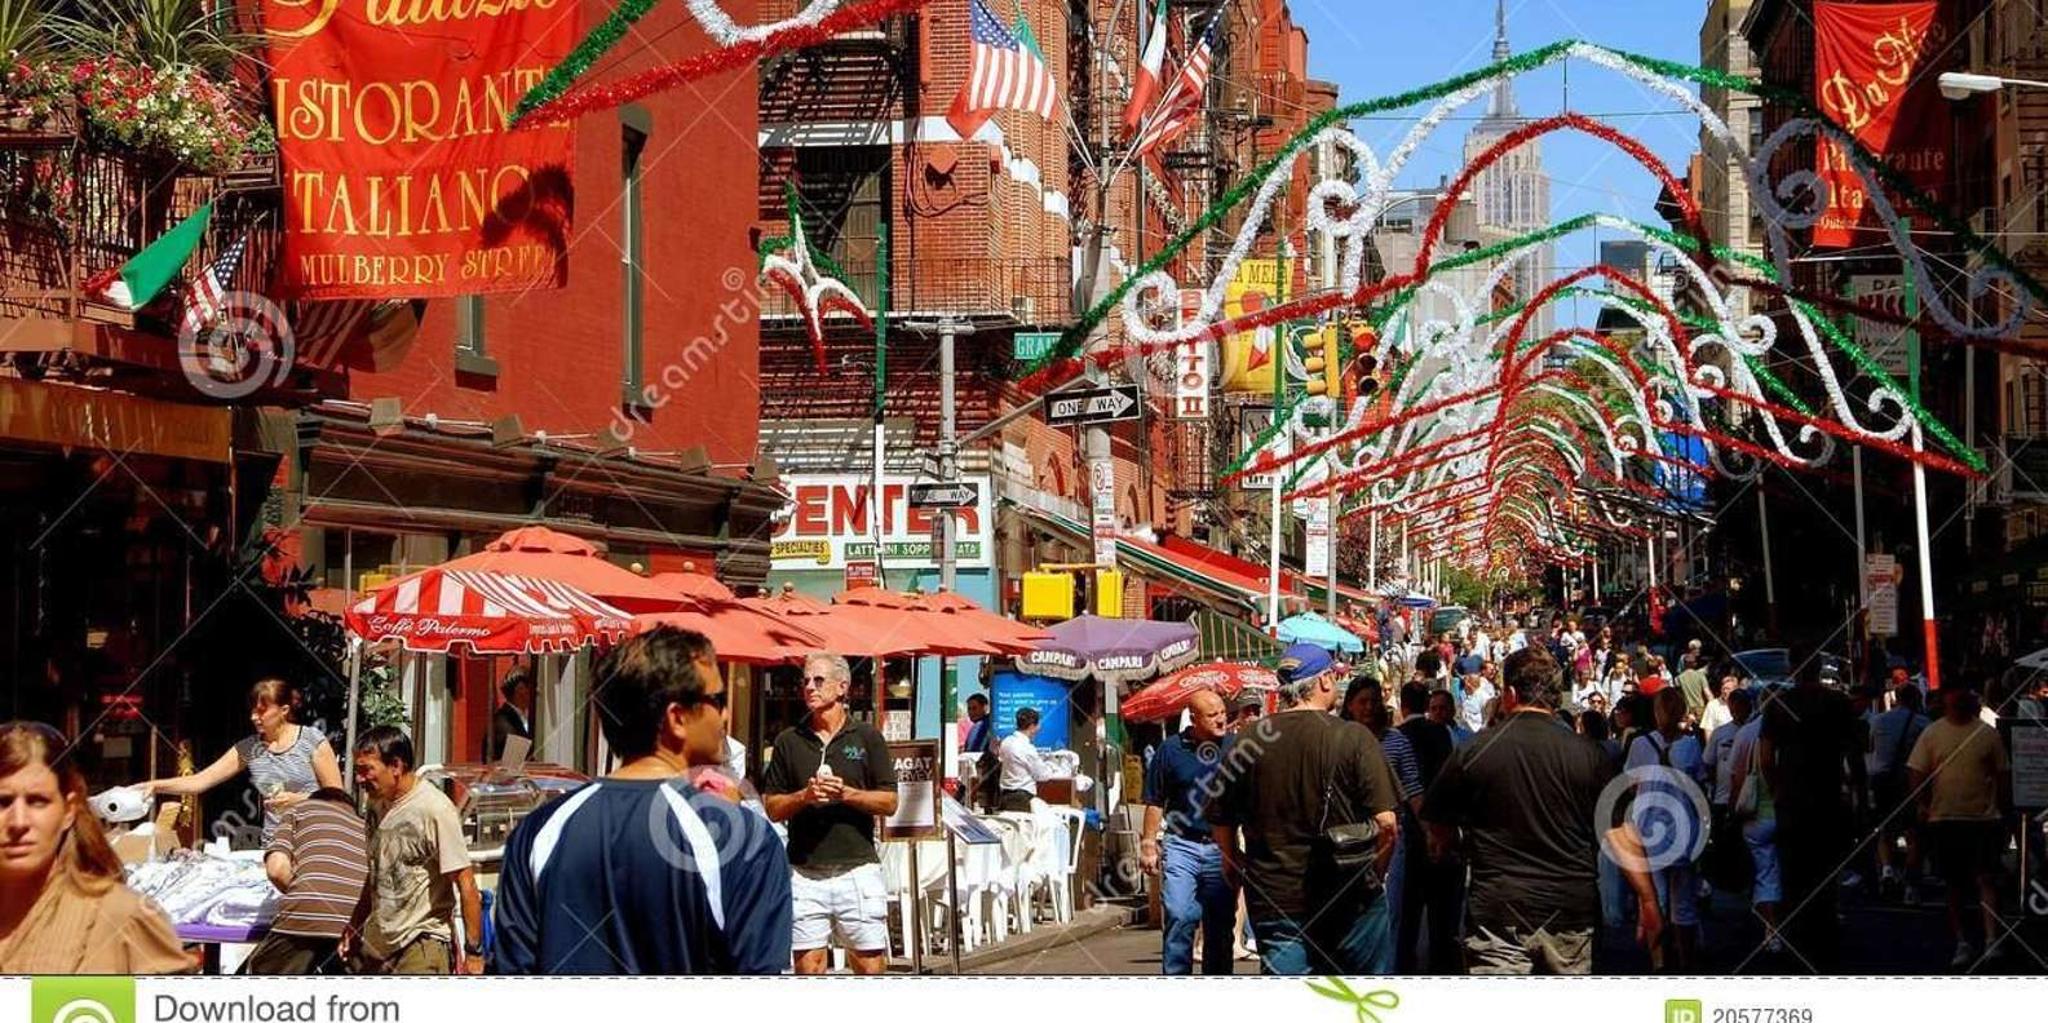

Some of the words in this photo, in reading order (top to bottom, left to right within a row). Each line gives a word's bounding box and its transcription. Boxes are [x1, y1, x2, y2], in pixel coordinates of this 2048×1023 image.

[274, 66, 570, 144] ISTORANT
[1822, 69, 1889, 134] Da
[300, 252, 450, 285] MULBERRY
[1057, 401, 1085, 415] ONE
[1096, 398, 1124, 411] WAY
[949, 490, 970, 499] WAY
[416, 618, 492, 636] Palermo
[1099, 656, 1143, 669] CAMPARI
[892, 756, 932, 770] AGAT
